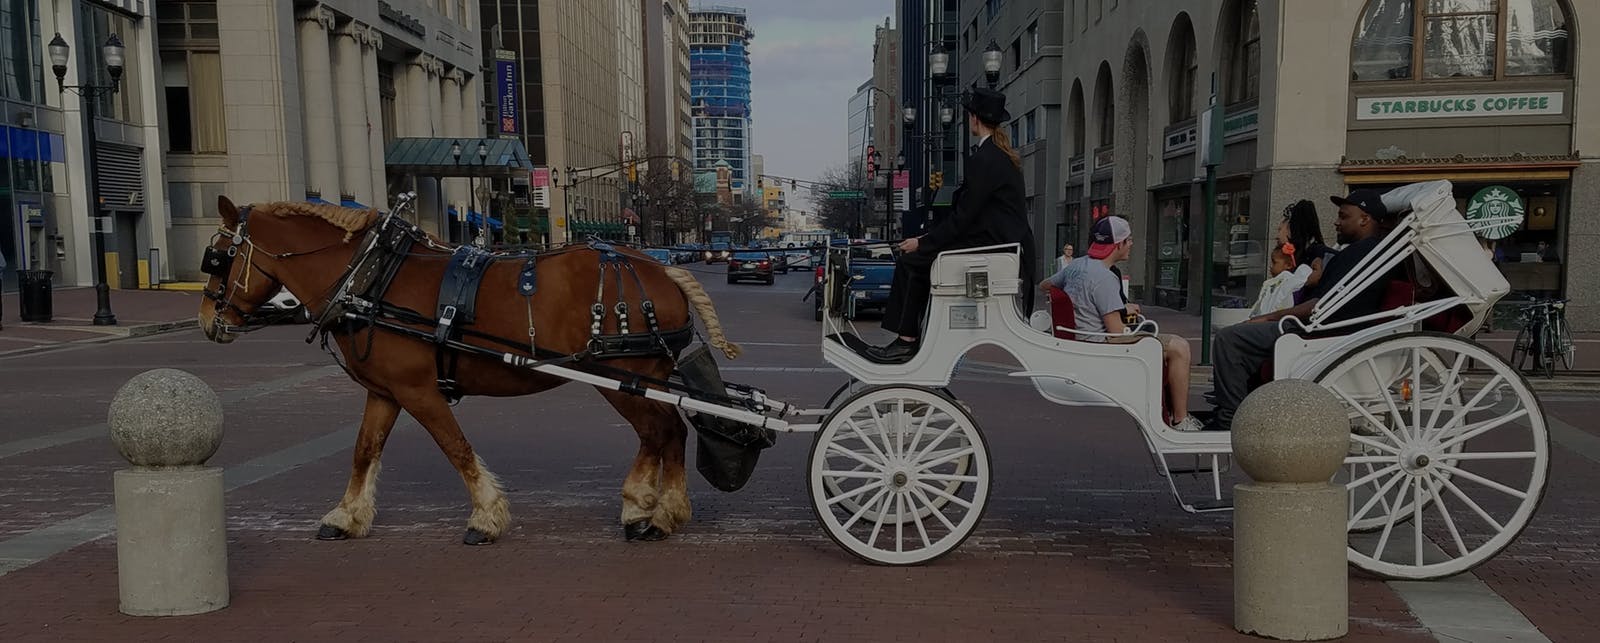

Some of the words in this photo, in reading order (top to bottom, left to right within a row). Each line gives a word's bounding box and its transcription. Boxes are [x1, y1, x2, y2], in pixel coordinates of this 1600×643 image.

[505, 64, 513, 81] Inn
[506, 83, 514, 118] Garden
[1370, 98, 1476, 115] STARBUCKS
[1482, 96, 1549, 112] COFFEE
[867, 146, 875, 181] PARK
